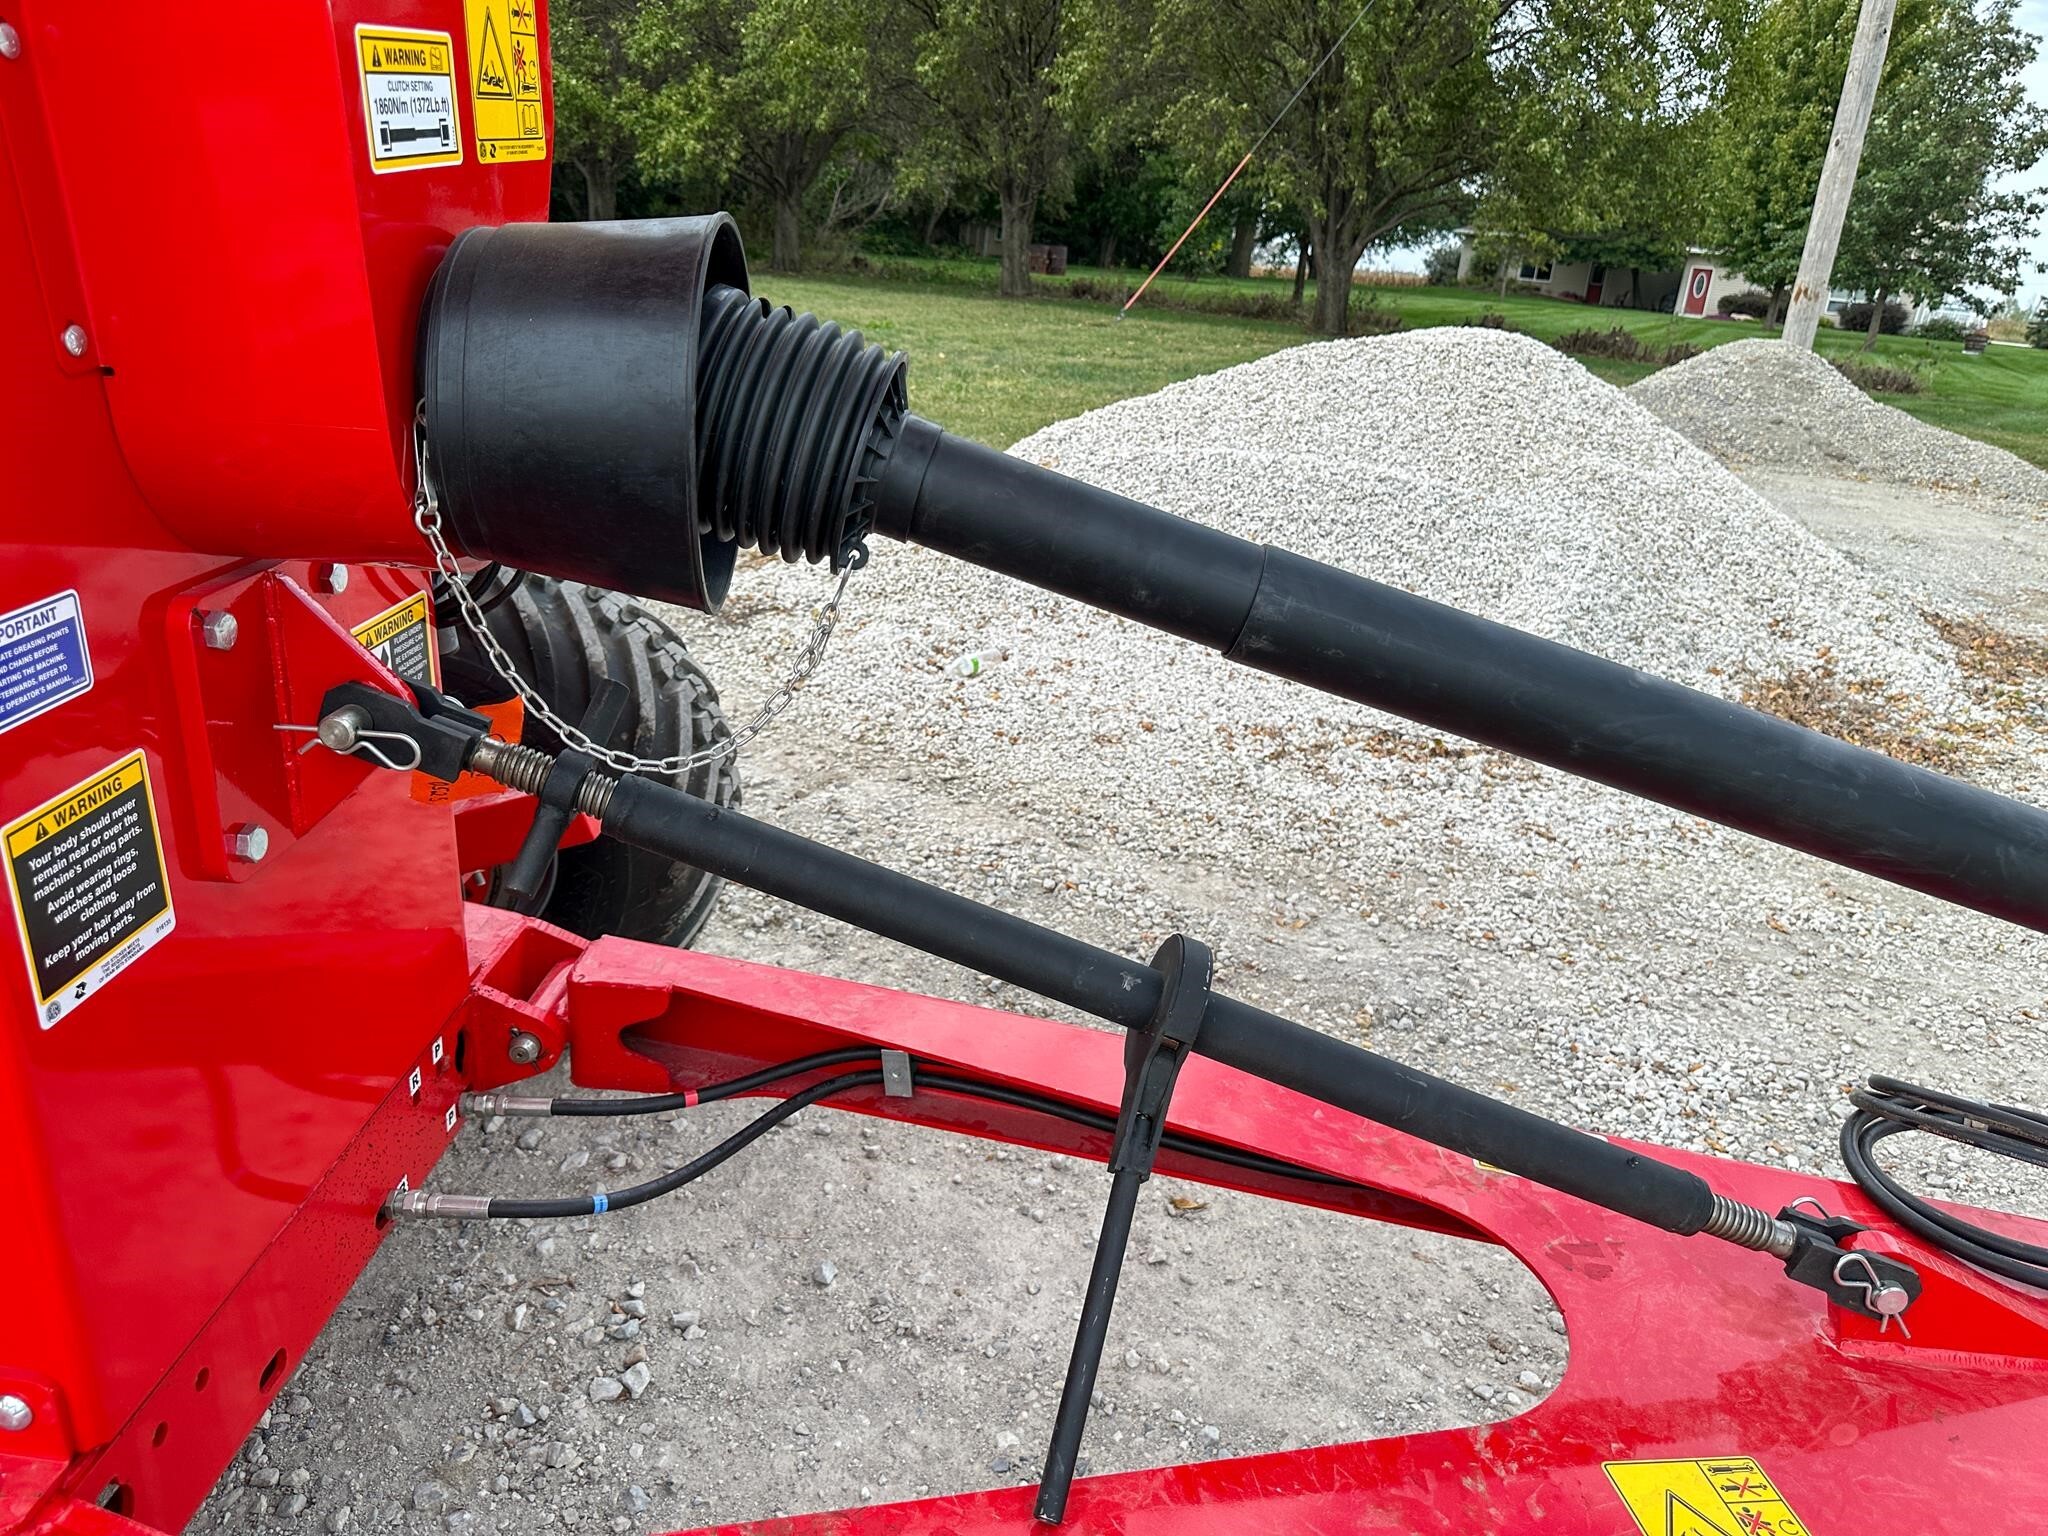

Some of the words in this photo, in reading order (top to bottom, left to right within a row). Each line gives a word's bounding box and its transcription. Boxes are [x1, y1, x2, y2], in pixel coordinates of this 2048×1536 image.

[384, 48, 426, 66] WARNING
[388, 80, 409, 92] CLUTCH
[411, 81, 433, 92] SETTING
[374, 97, 409, 115] 1860N/m
[13, 637, 47, 655] GREASING
[47, 626, 70, 640] POINTS
[374, 609, 414, 642] WARNING
[9, 654, 34, 670] CHAINS
[34, 643, 59, 659] BEFORE
[22, 663, 36, 676] THE
[36, 653, 67, 671] MACHINE.
[38, 667, 59, 682] REFER
[59, 663, 68, 675] TO
[6, 687, 46, 710] OPERATOR'S
[46, 674, 73, 692] MANUAL.
[53, 777, 123, 827] WARNING
[28, 853, 52, 871] Your
[53, 835, 79, 857] body
[79, 812, 111, 840] should
[111, 798, 137, 820] never
[33, 860, 68, 886] remain
[69, 845, 91, 863] near
[91, 837, 103, 848] or
[103, 823, 123, 841] over
[124, 812, 139, 829] the
[33, 864, 83, 901] machine's
[83, 842, 117, 869] moving
[118, 826, 143, 850] parts.
[46, 887, 75, 914] Avoid
[76, 865, 113, 895] wearing
[113, 848, 139, 872] rings,
[53, 893, 94, 924] watches
[95, 879, 113, 897] and
[113, 862, 137, 885] loose
[79, 889, 120, 922] clothing.
[44, 944, 71, 969] Keep
[71, 930, 94, 951] your
[94, 914, 112, 933] hair
[113, 898, 136, 919] away
[136, 881, 157, 901] from
[75, 932, 110, 961] moving
[110, 913, 136, 938] parts.
[434, 1043, 441, 1058] P
[412, 1074, 419, 1089] R
[448, 1110, 454, 1123] P
